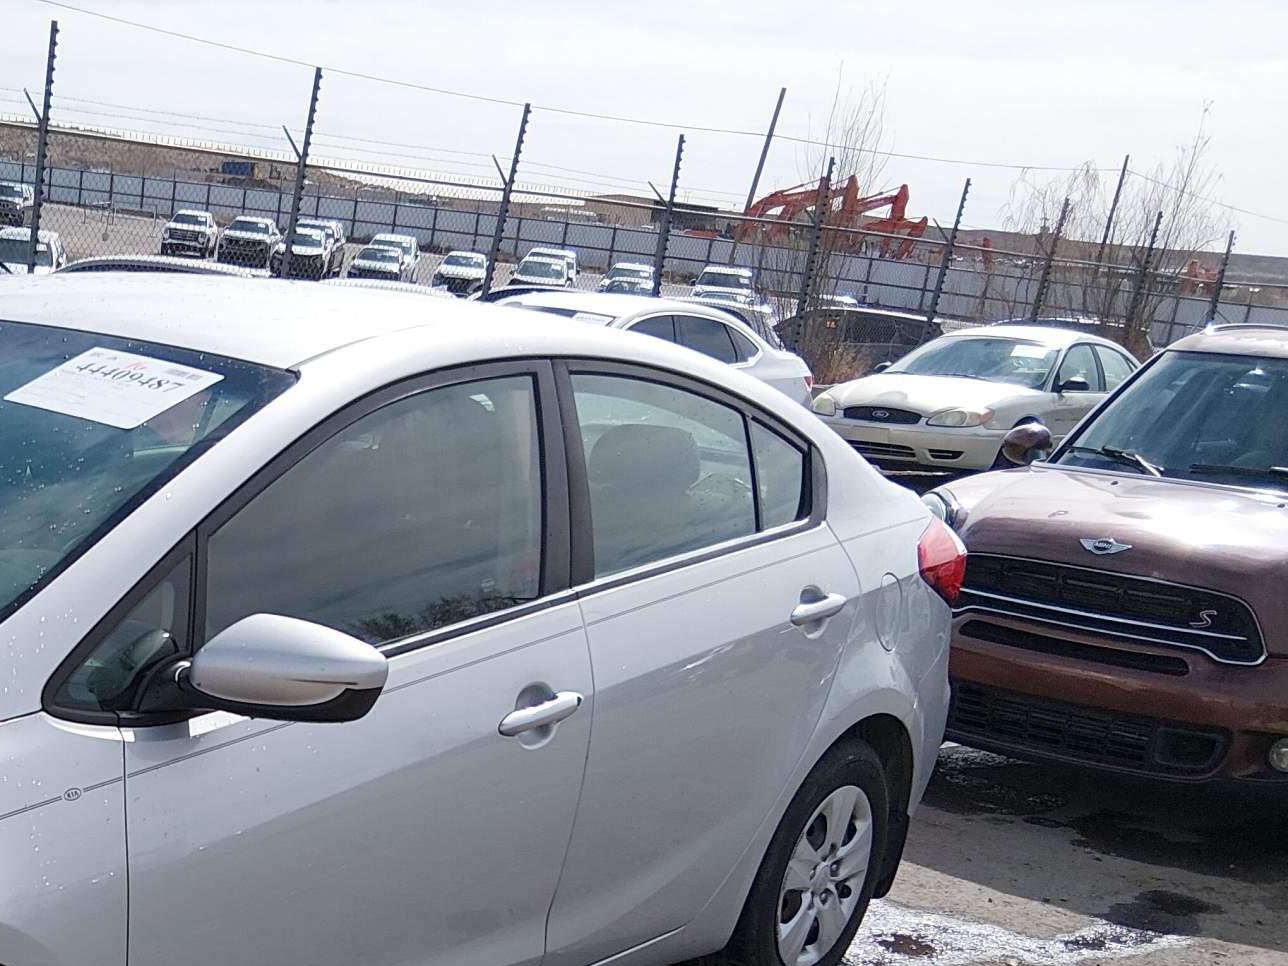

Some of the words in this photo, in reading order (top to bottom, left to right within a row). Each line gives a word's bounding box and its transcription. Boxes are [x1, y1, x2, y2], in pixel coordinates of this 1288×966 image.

[76, 362, 185, 393] 44409487
[1188, 609, 1218, 628] S
[66, 789, 80, 799] KIA
